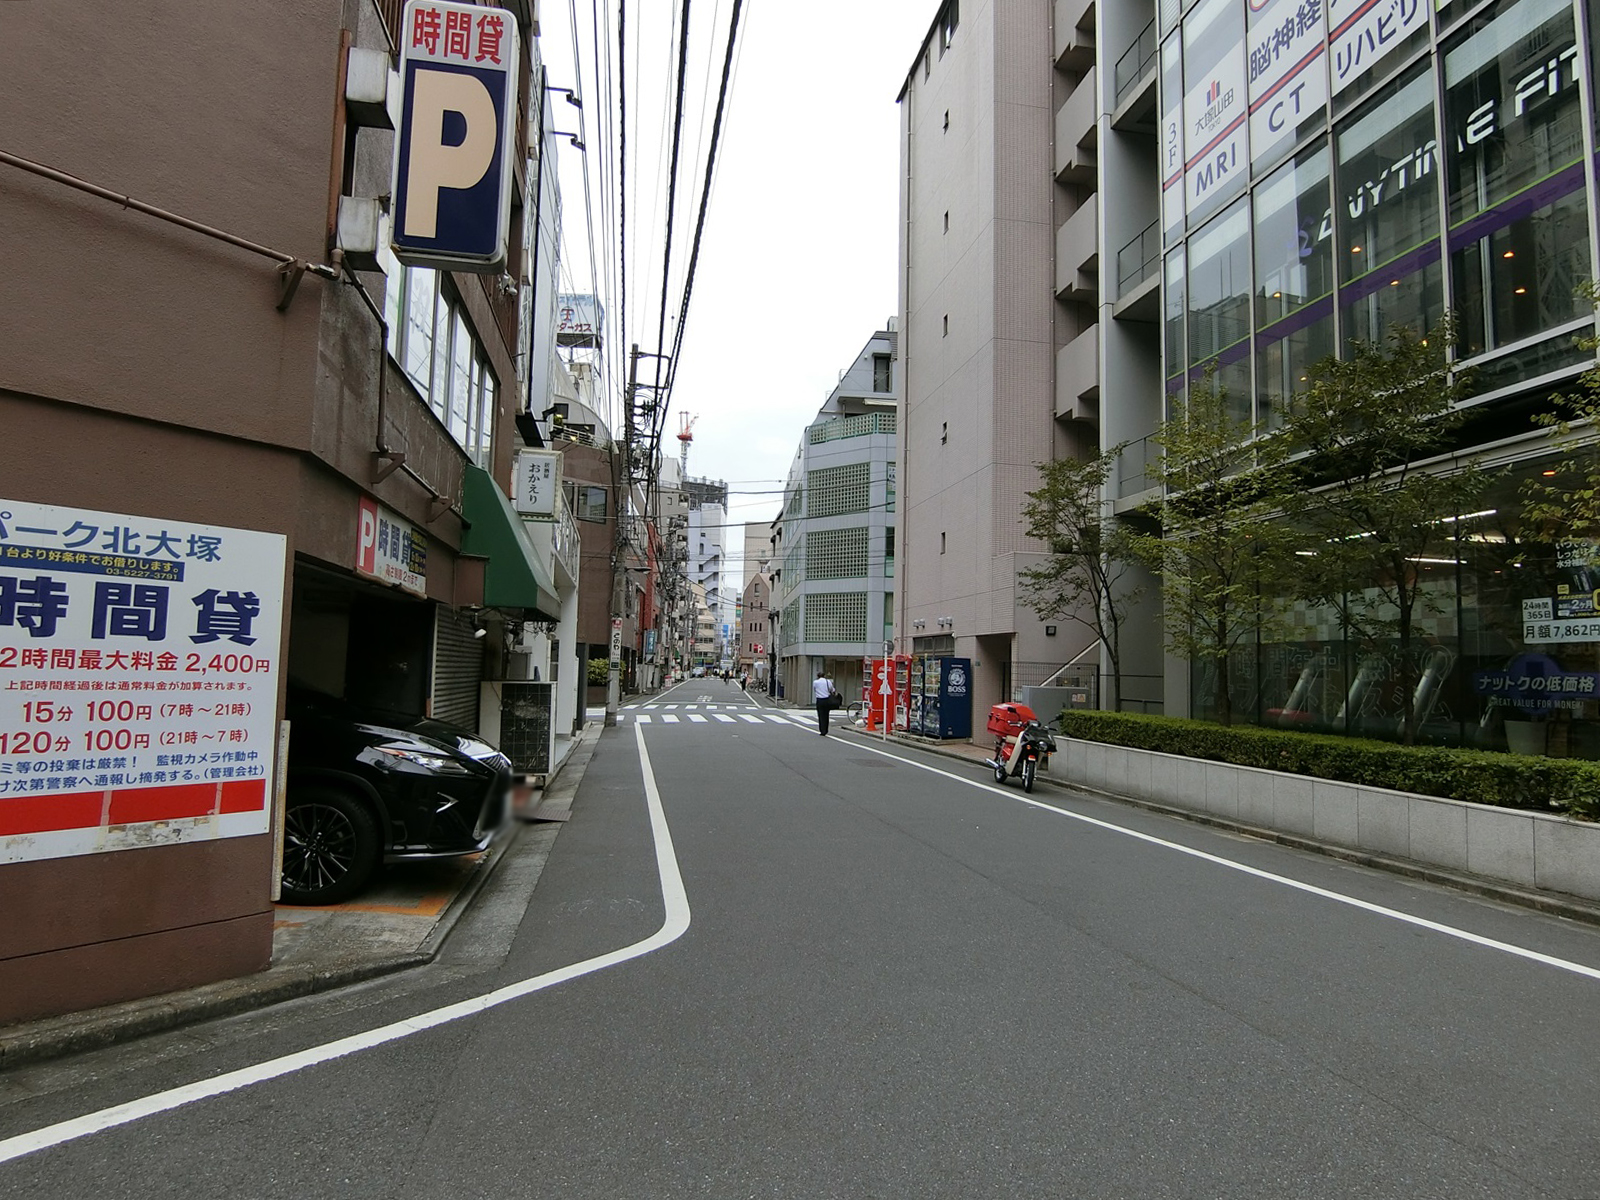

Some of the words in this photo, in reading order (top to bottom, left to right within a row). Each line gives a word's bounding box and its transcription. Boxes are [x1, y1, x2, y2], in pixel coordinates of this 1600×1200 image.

[412, 7, 504, 65] 時間貸
[1250, 0, 1323, 84] 脳神経
[1337, 0, 1419, 79] リハビリ
[403, 68, 497, 239] P
[1195, 141, 1236, 197] MRI
[528, 462, 541, 505] おかえり
[359, 508, 375, 567] P
[378, 518, 413, 567] 時間貸
[105, 567, 178, 581] 03-5227-3791
[0, 575, 261, 647] 時間貸
[1523, 601, 1550, 611] 24時間
[1527, 610, 1552, 620] 365日
[1525, 624, 1552, 640] 月額
[1553, 624, 1600, 639] 7,862円
[0, 646, 178, 672] 2時間最大料金
[185, 653, 271, 676] 2,400円
[947, 685, 967, 694] BOSS
[1478, 675, 1596, 693] ナットクの低価格
[23, 700, 74, 723] 15分
[87, 700, 152, 722] 100円
[1512, 699, 1536, 708] VALUE
[1536, 699, 1553, 709] FOR
[0, 730, 72, 755] 120分
[84, 729, 151, 752] 100円
[156, 750, 259, 766] 監視カメラ作動中
